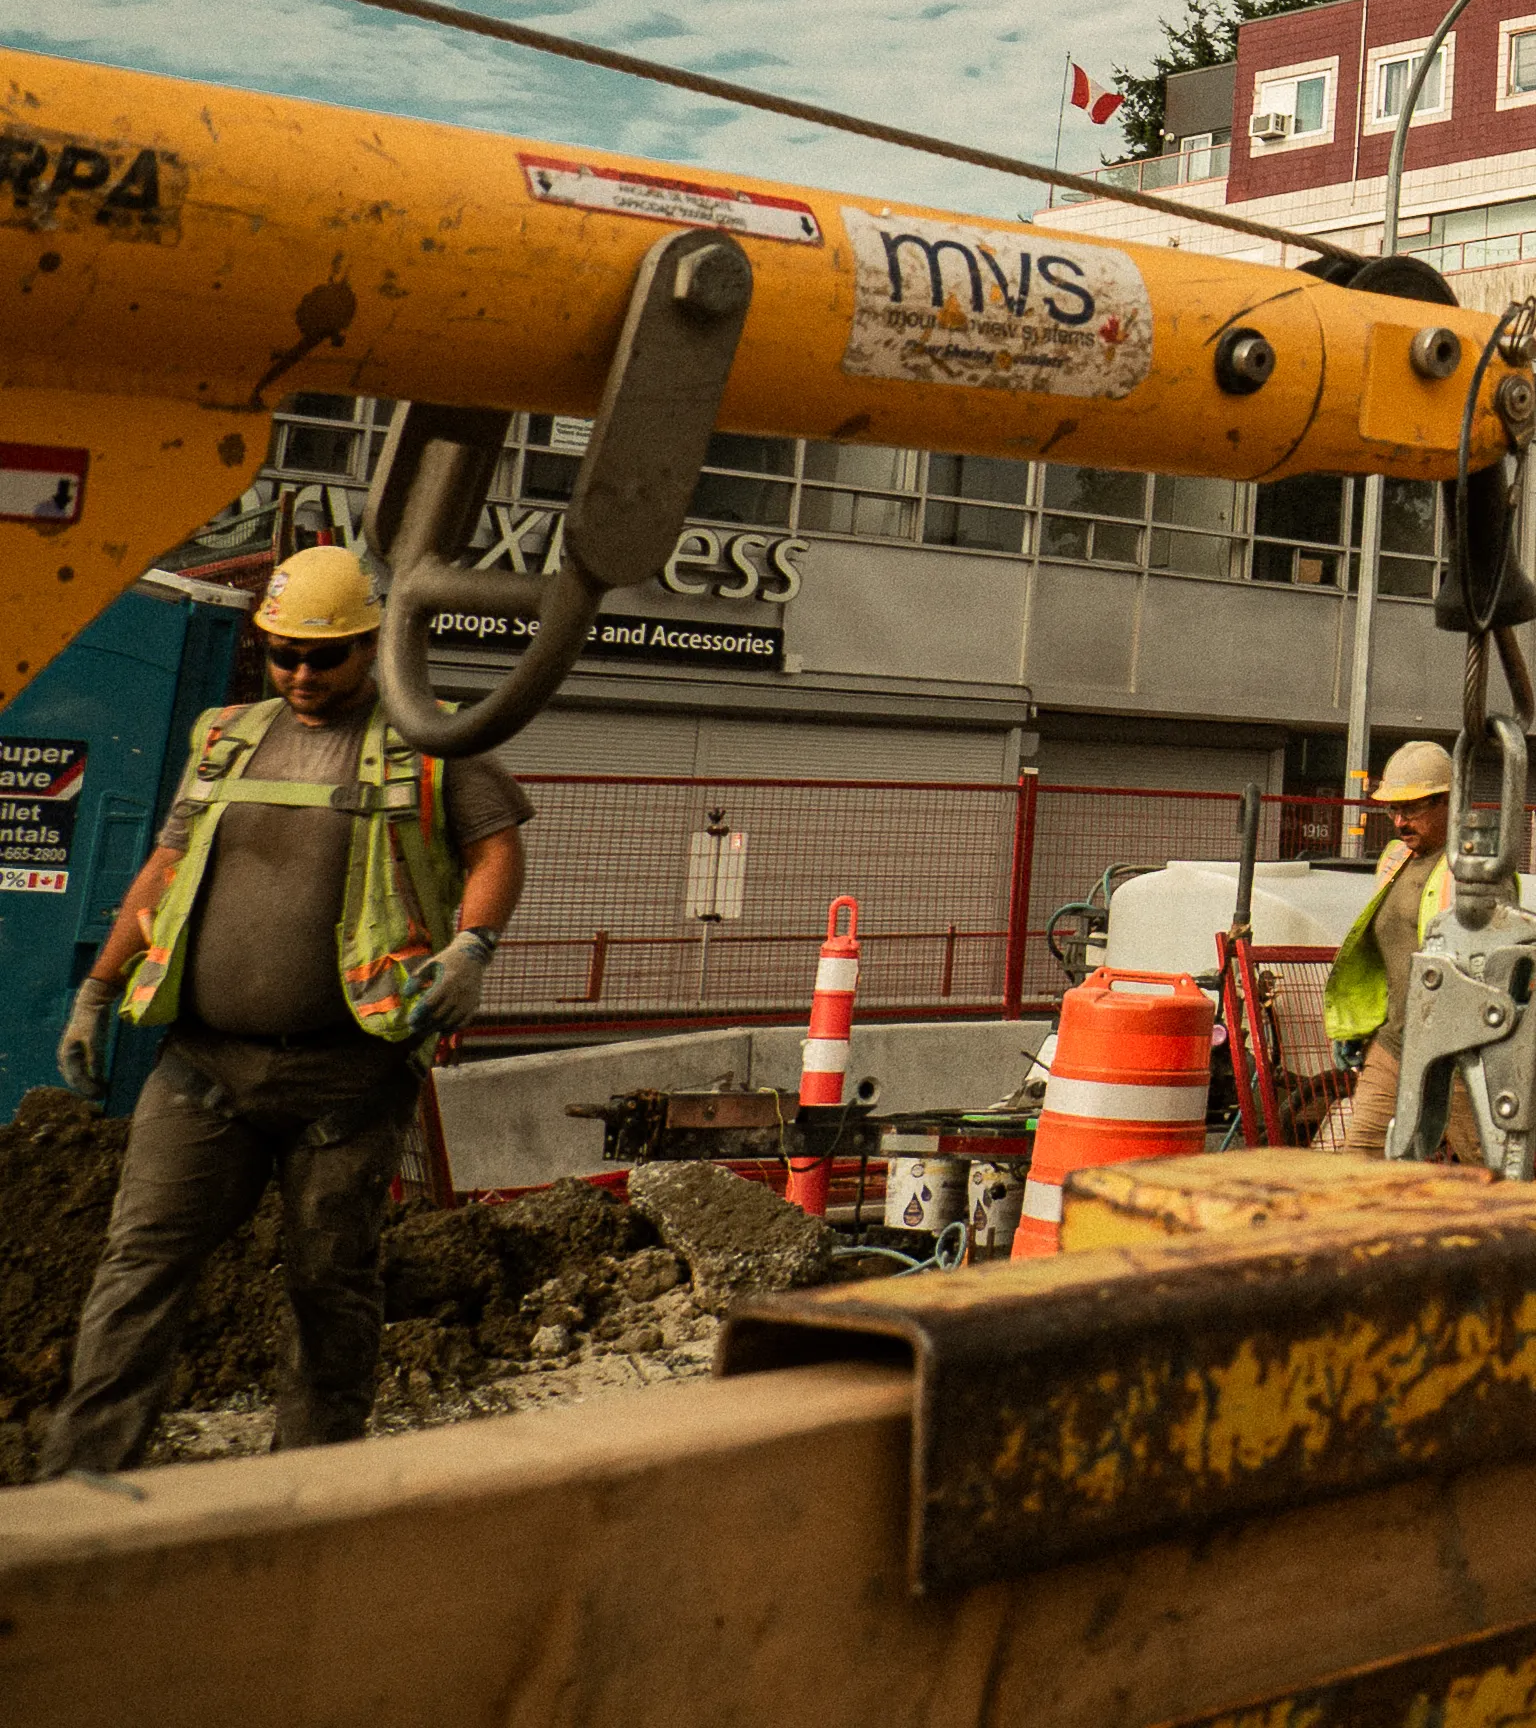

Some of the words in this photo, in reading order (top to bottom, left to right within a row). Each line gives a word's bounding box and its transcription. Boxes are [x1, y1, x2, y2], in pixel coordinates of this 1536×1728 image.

[880, 232, 1095, 323] mvs
[602, 623, 646, 645] and
[651, 625, 774, 655] Accessories
[0, 741, 74, 767] uper
[1303, 823, 1329, 838] 1916
